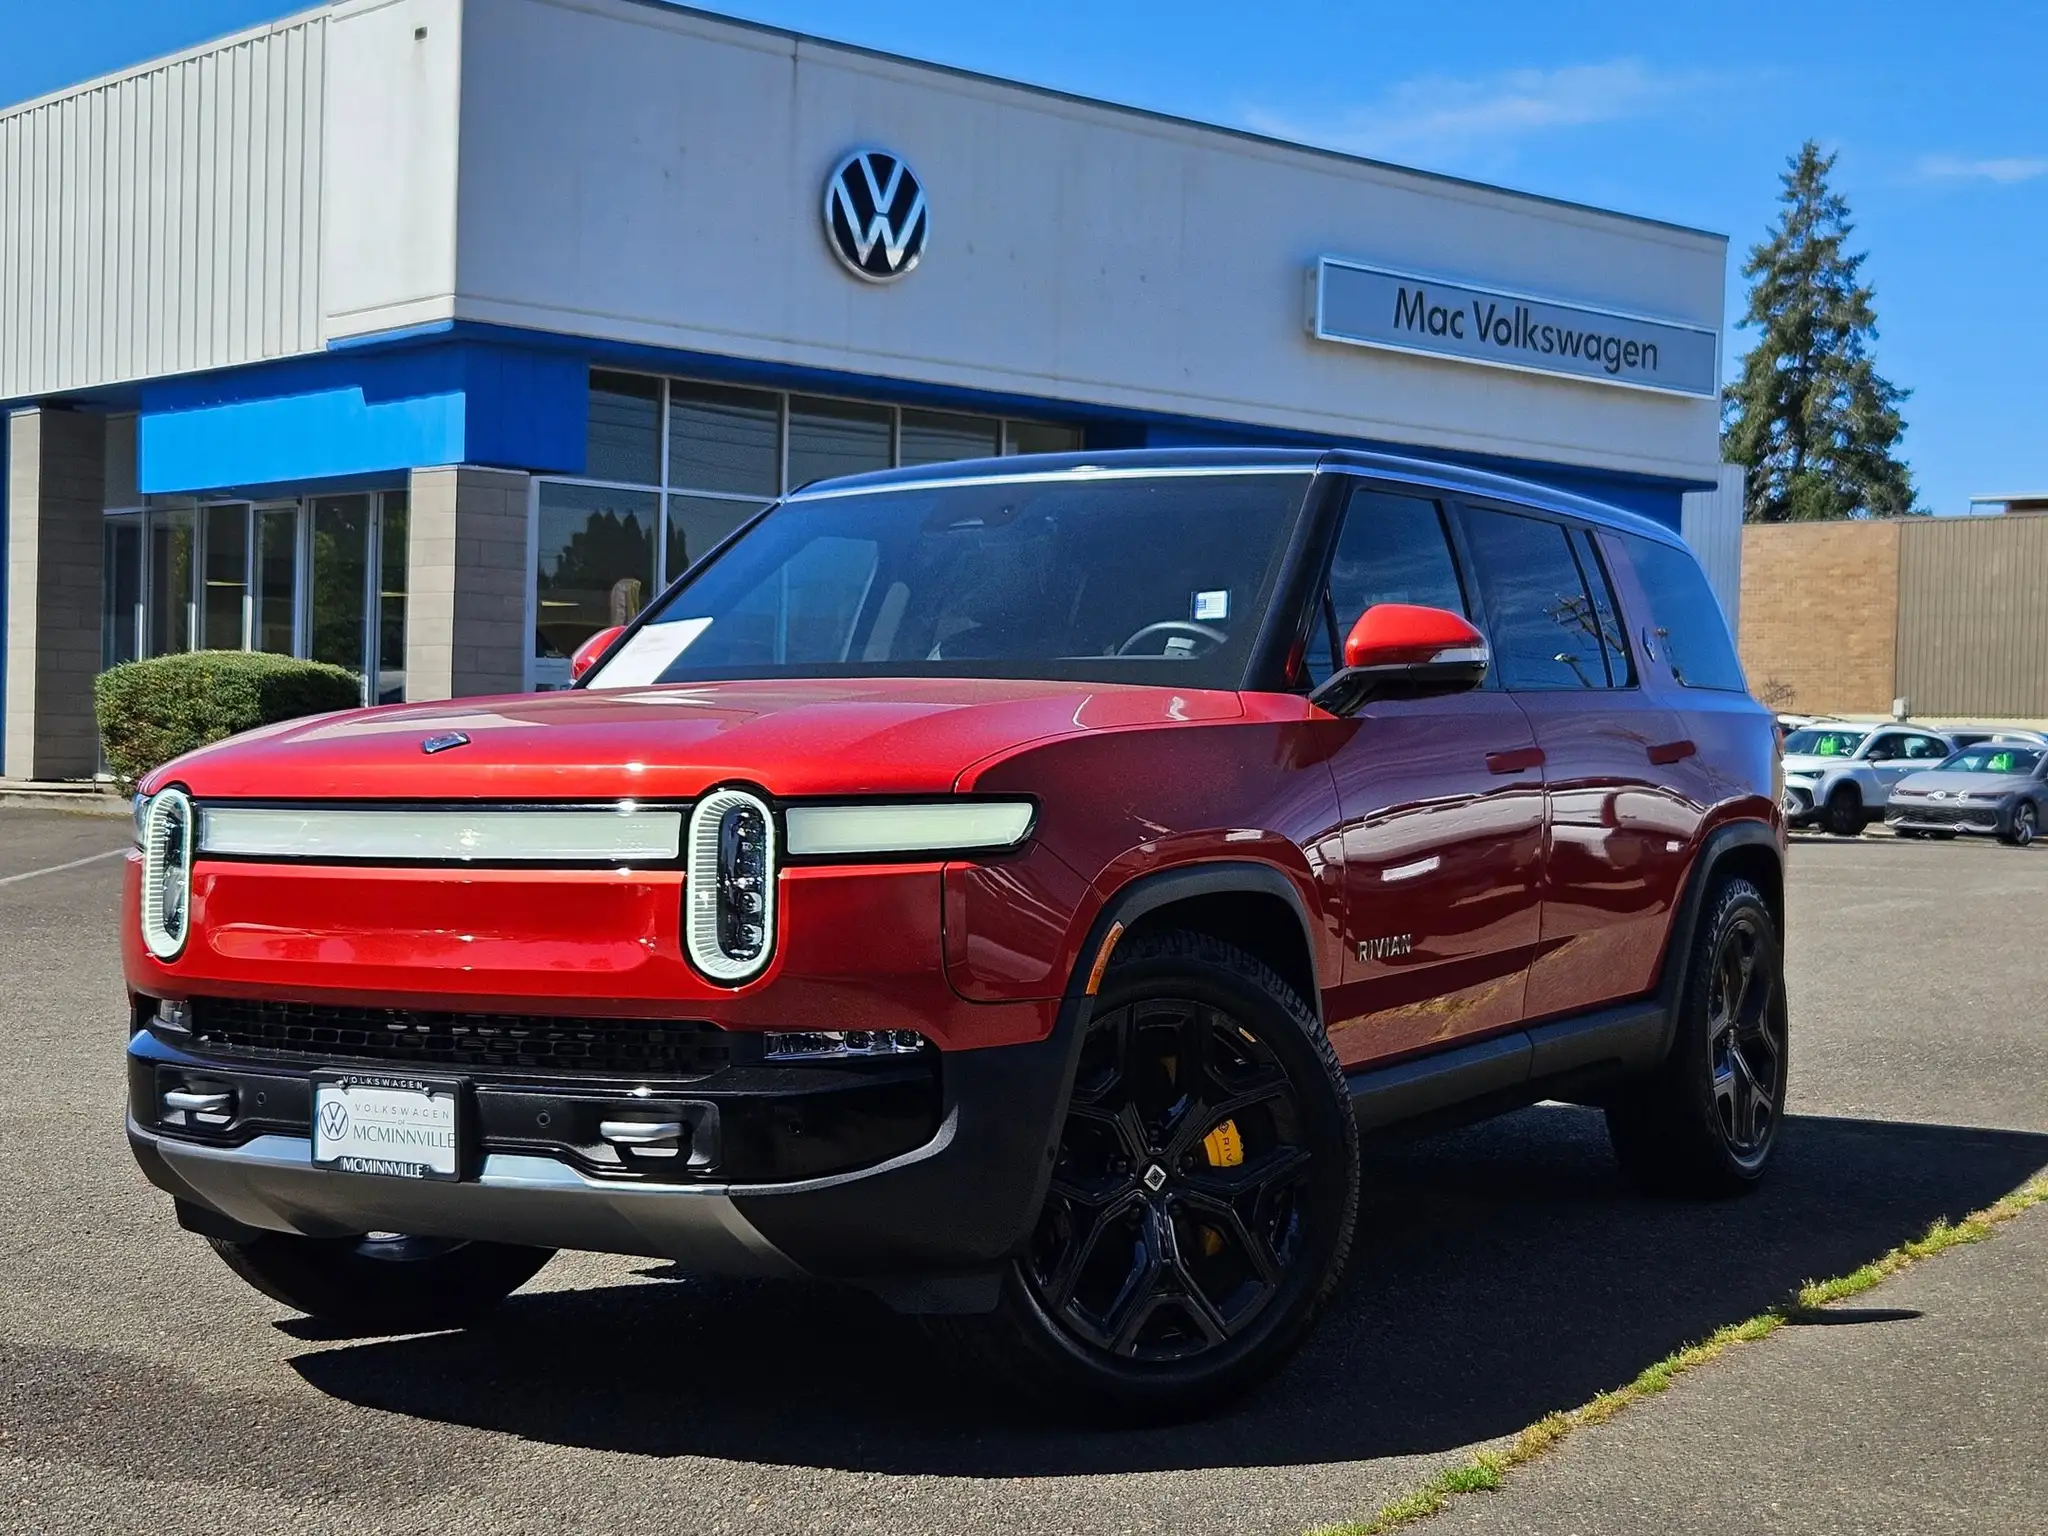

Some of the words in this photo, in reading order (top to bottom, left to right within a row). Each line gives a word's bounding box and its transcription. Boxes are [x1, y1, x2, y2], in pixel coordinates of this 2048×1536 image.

[1393, 287, 1464, 339] Mac
[1472, 300, 1659, 374] Volkswagen
[1358, 933, 1412, 962] RIVIAN
[344, 1075, 423, 1088] VOLKSWAGEN
[355, 1103, 449, 1119] VOLKSWAGEN
[353, 1125, 455, 1148] MCMINNVILLE
[343, 1157, 424, 1178] MCMINNVILLE
